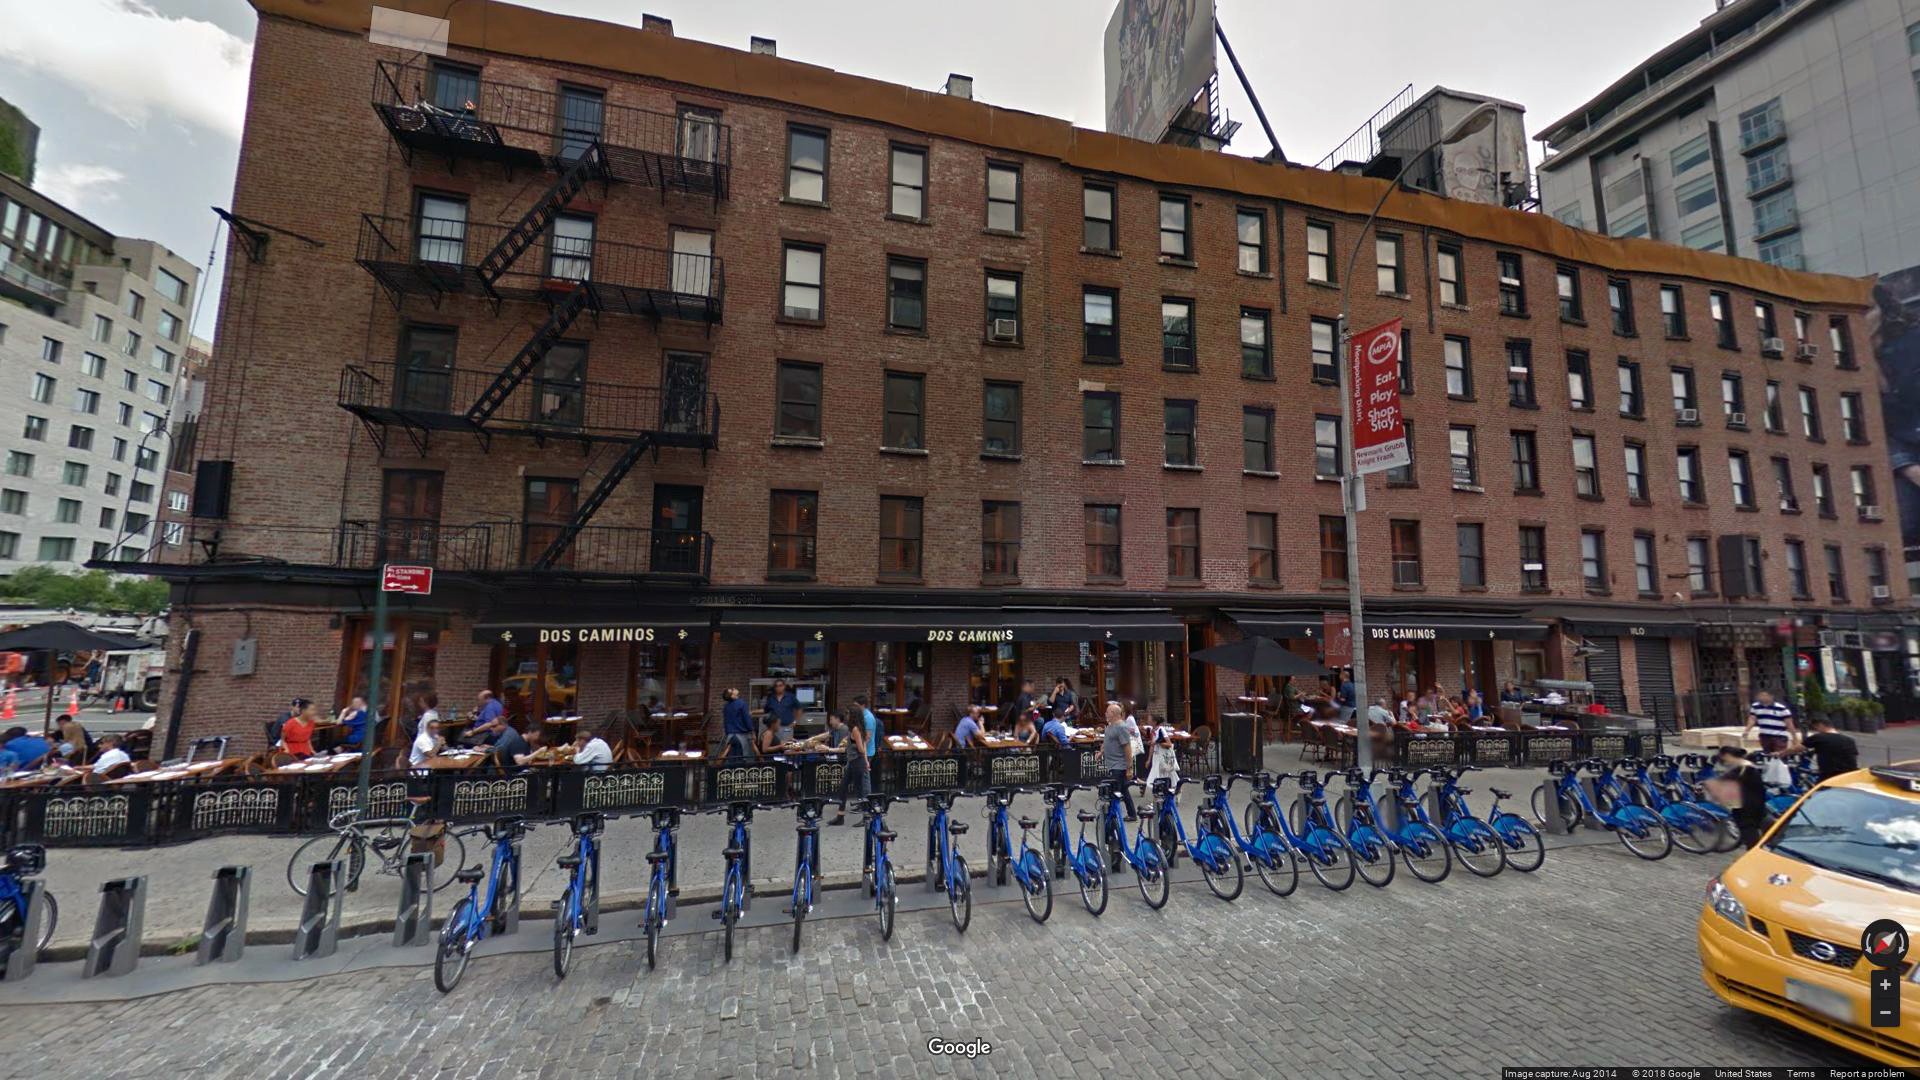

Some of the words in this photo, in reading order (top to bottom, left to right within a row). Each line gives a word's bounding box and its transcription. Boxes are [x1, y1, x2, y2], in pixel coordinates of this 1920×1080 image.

[1375, 370, 1396, 386] Eat.
[1370, 389, 1397, 405] Play.
[1367, 406, 1399, 421] Shop.
[1371, 417, 1400, 432] Stay.
[540, 629, 571, 643] DOS
[578, 628, 655, 642] CAMINOS
[927, 629, 954, 642] DOS
[1371, 628, 1390, 639] DOS
[1392, 628, 1436, 639] CAMINOS
